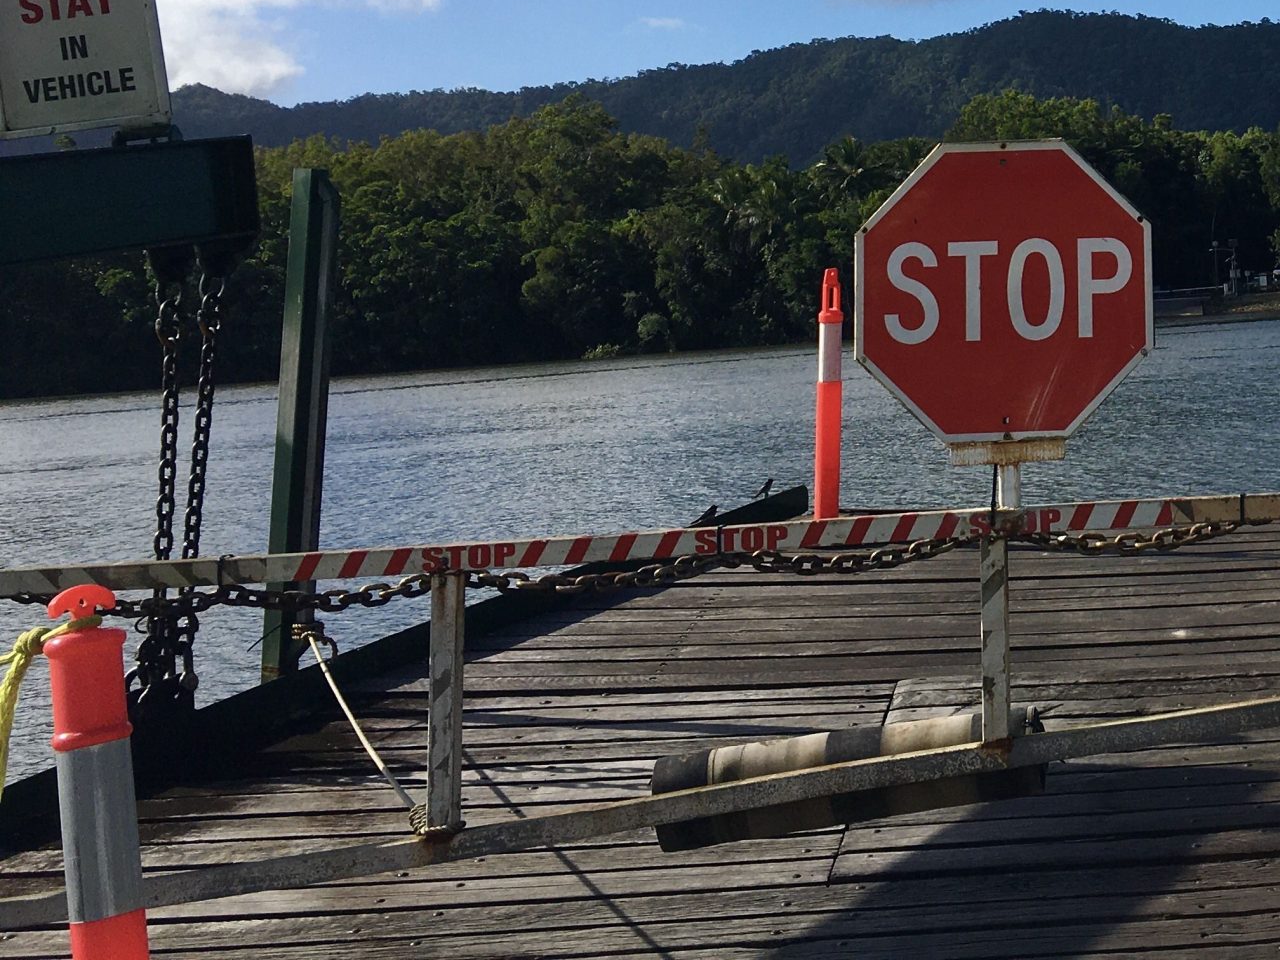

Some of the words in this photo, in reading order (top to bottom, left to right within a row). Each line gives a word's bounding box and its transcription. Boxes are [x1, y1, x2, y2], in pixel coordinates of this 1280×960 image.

[60, 35, 88, 61] IN
[23, 67, 136, 104] VEHICLE
[884, 237, 1133, 345] STOP
[969, 508, 1062, 537] SOP
[695, 525, 788, 554] STOP
[422, 542, 516, 572] STOP
